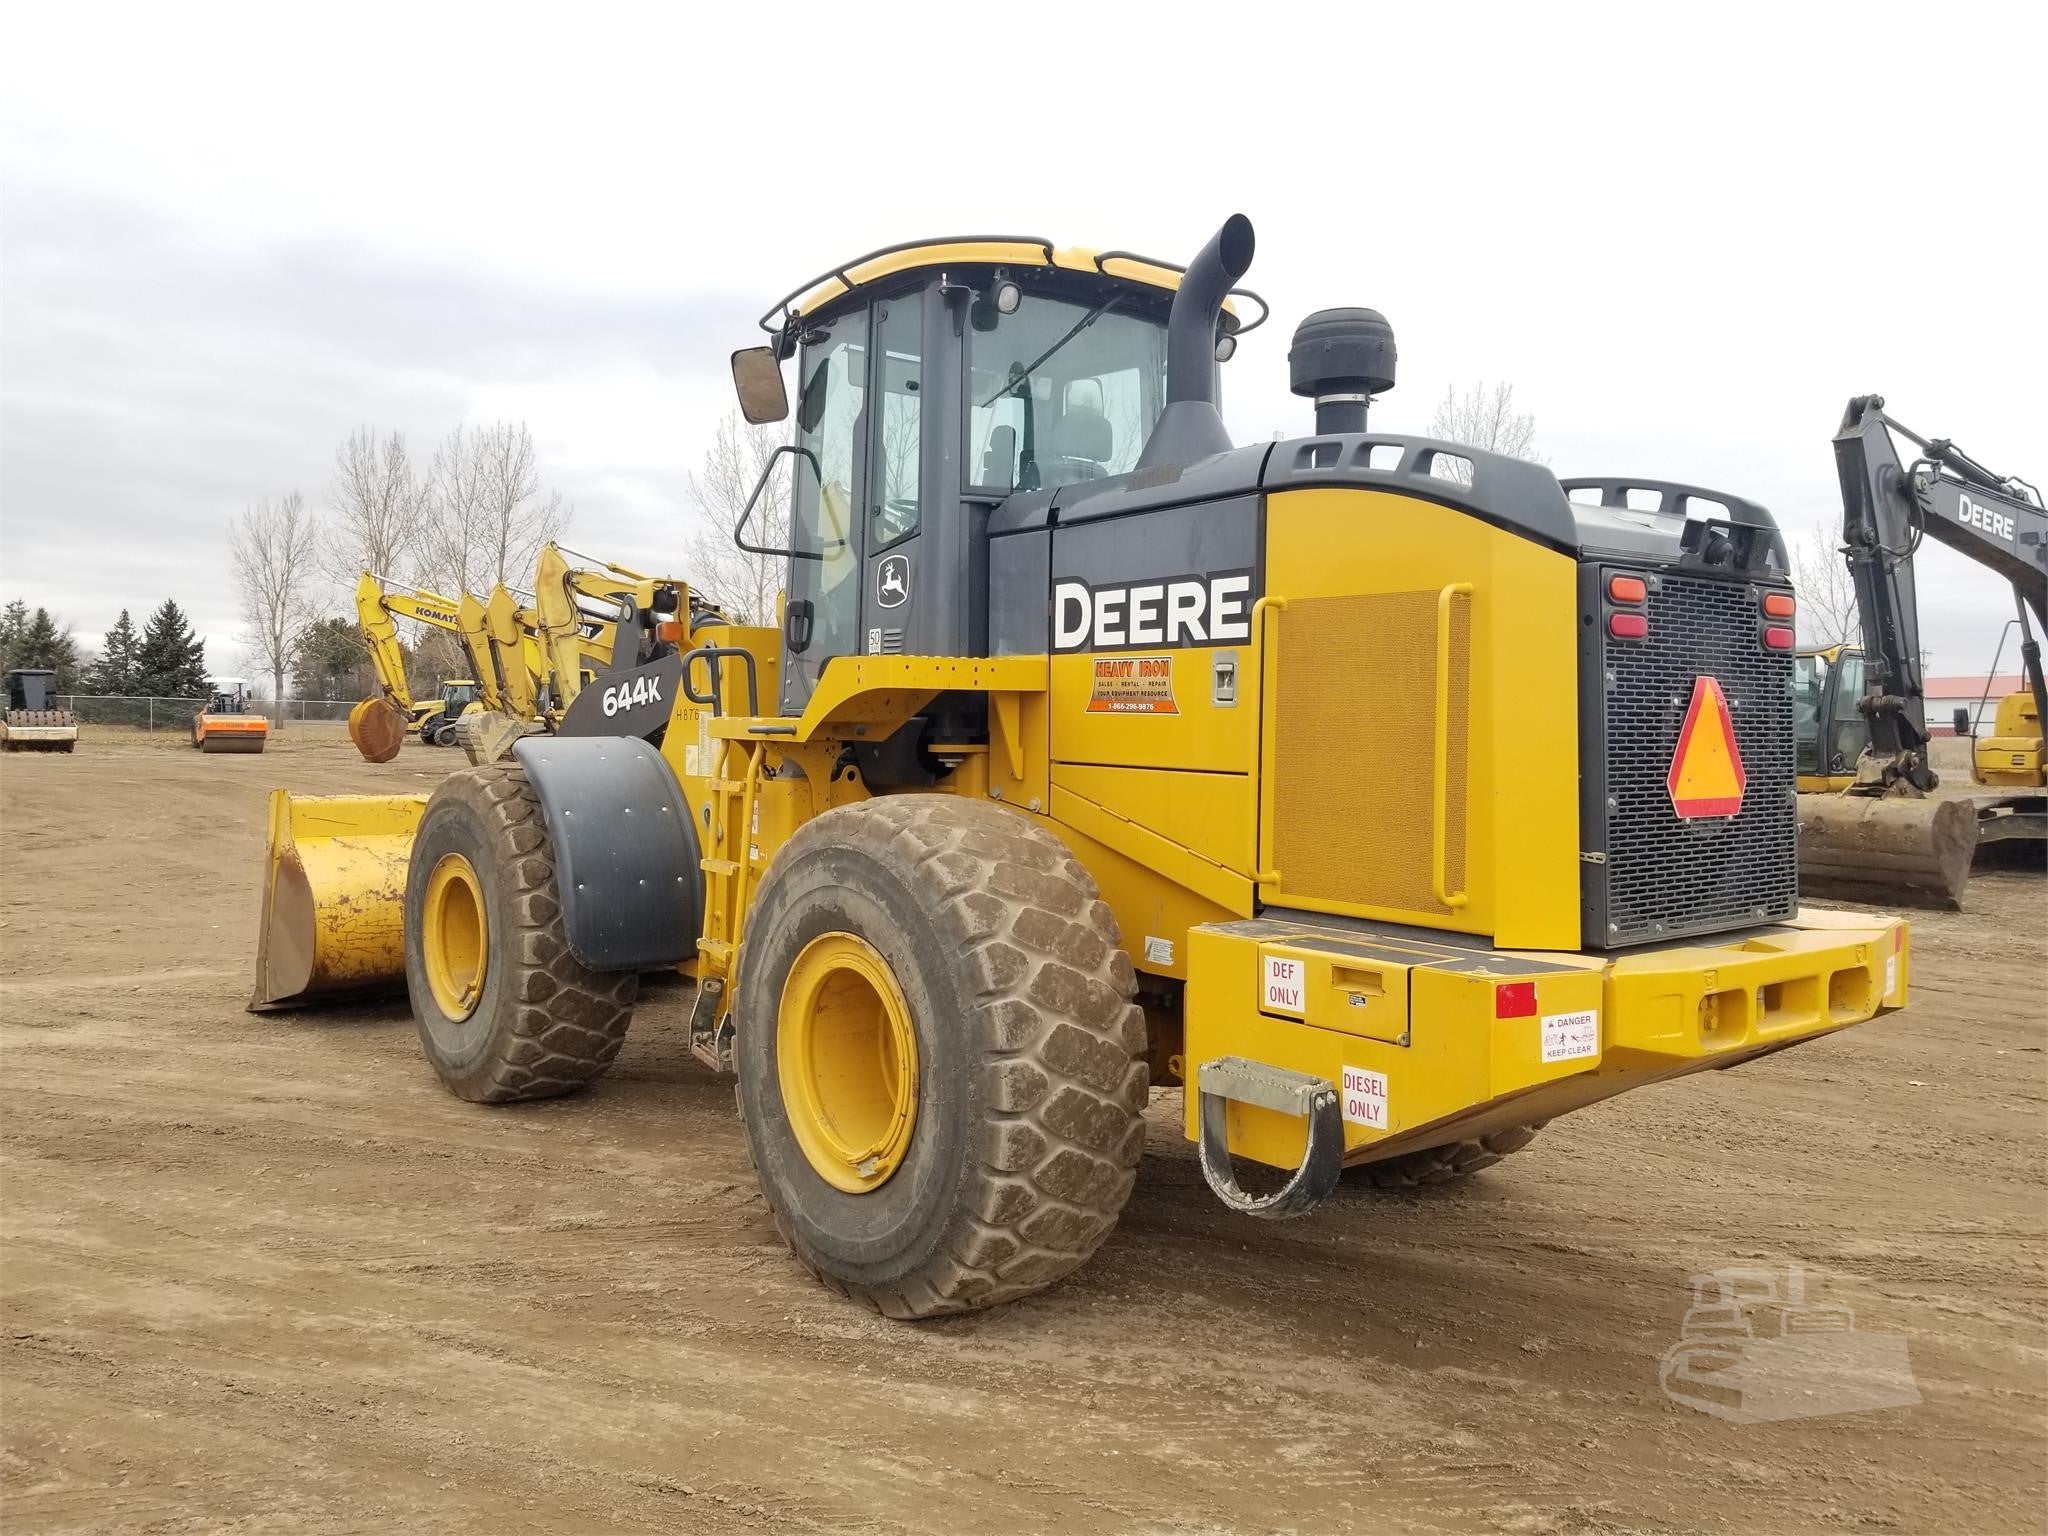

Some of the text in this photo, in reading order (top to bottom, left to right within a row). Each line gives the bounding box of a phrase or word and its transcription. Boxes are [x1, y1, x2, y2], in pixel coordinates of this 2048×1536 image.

[1958, 493, 2014, 541] DEERE
[1054, 575, 1250, 649] DEERE
[577, 623, 594, 638] AT
[1095, 660, 1169, 678] HEAVY IRON
[602, 675, 662, 717] 644K
[1273, 961, 1295, 980] DEF
[1269, 985, 1299, 1006] ONLY
[1557, 1015, 1591, 1028] DANGER
[1547, 1045, 1591, 1058] KEEP CLEAR
[1344, 1073, 1386, 1098] DIESEL
[1349, 1099, 1380, 1122] ONLY
